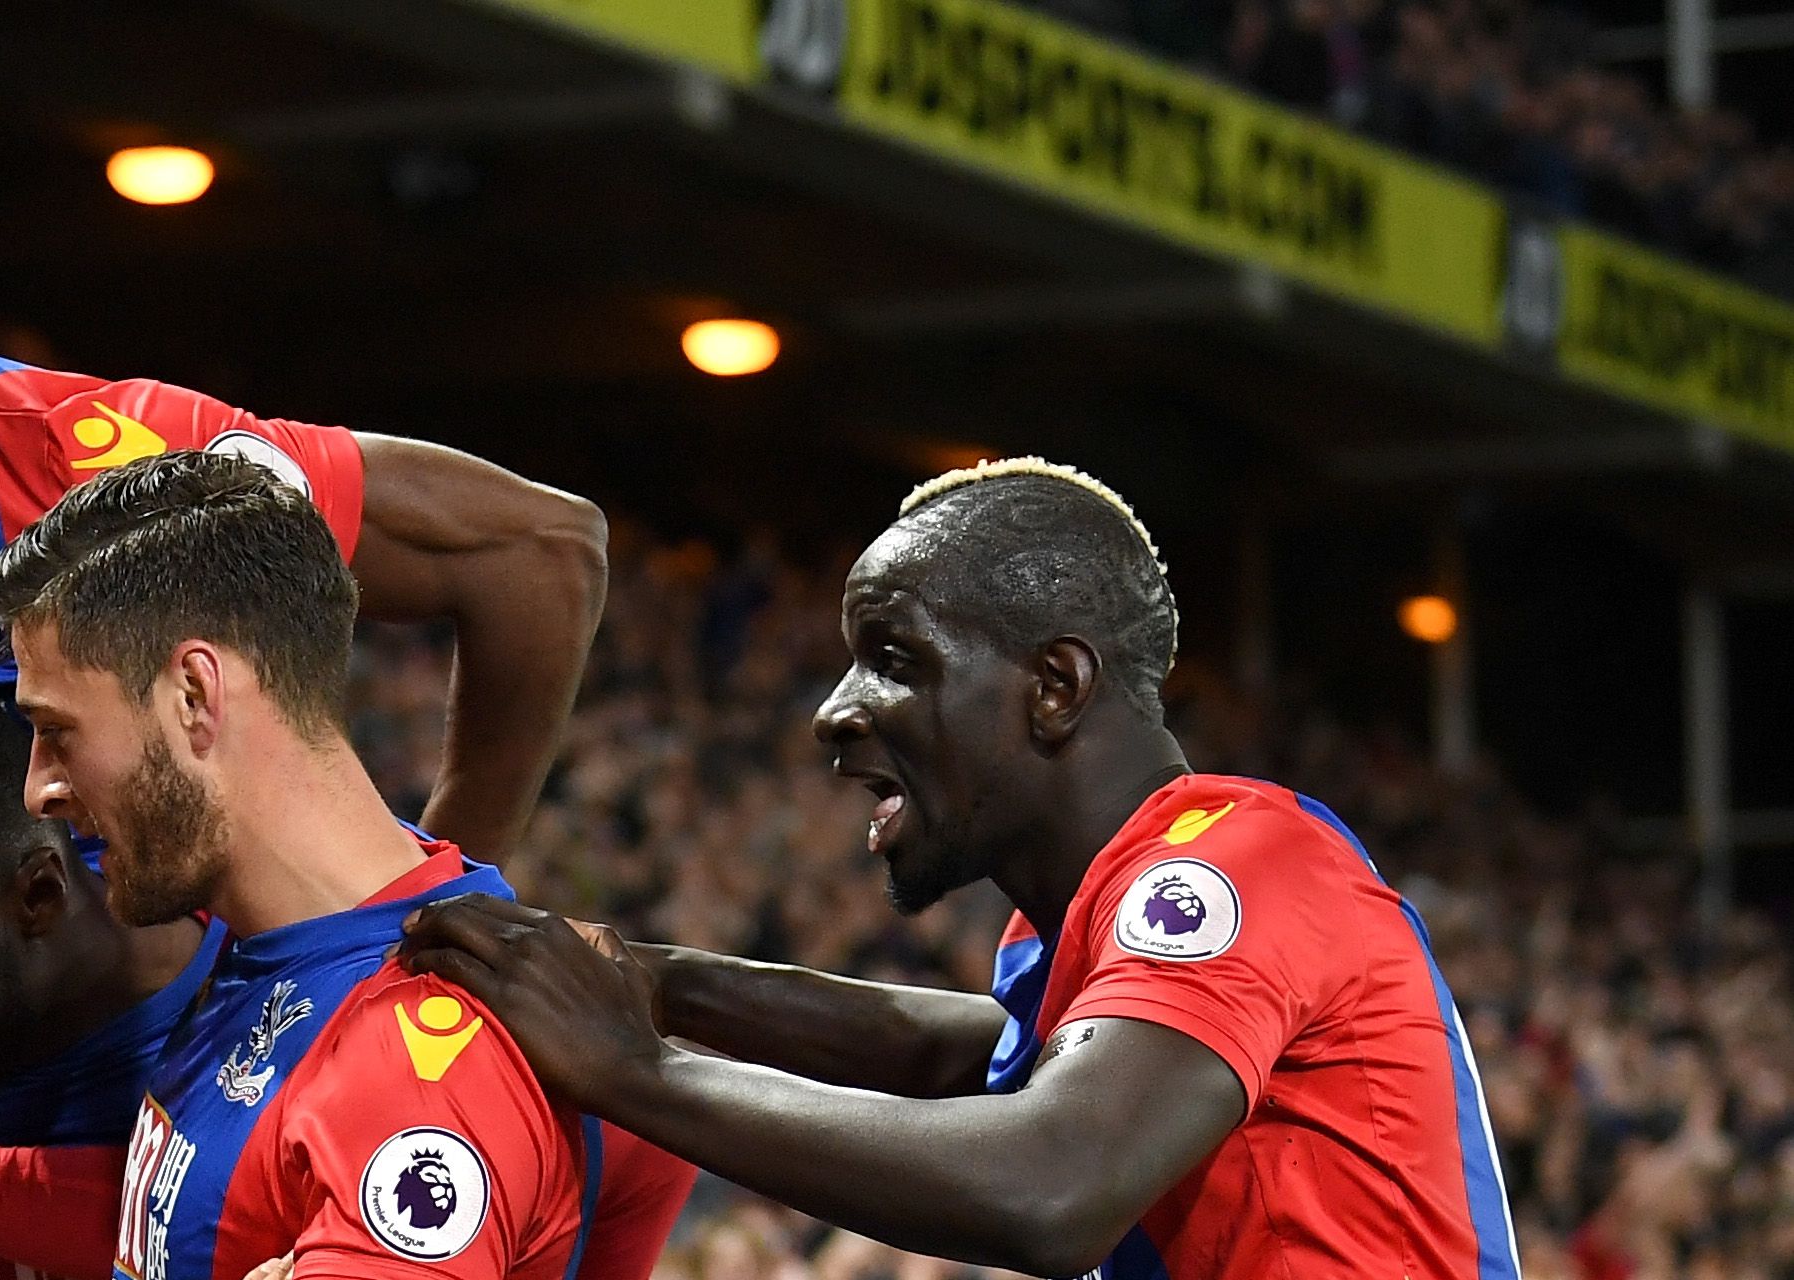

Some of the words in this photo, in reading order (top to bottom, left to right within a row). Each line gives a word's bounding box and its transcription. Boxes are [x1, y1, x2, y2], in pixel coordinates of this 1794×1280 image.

[1143, 937, 1185, 951] League
[371, 1185, 388, 1225] Premier
[387, 1223, 426, 1247] League
